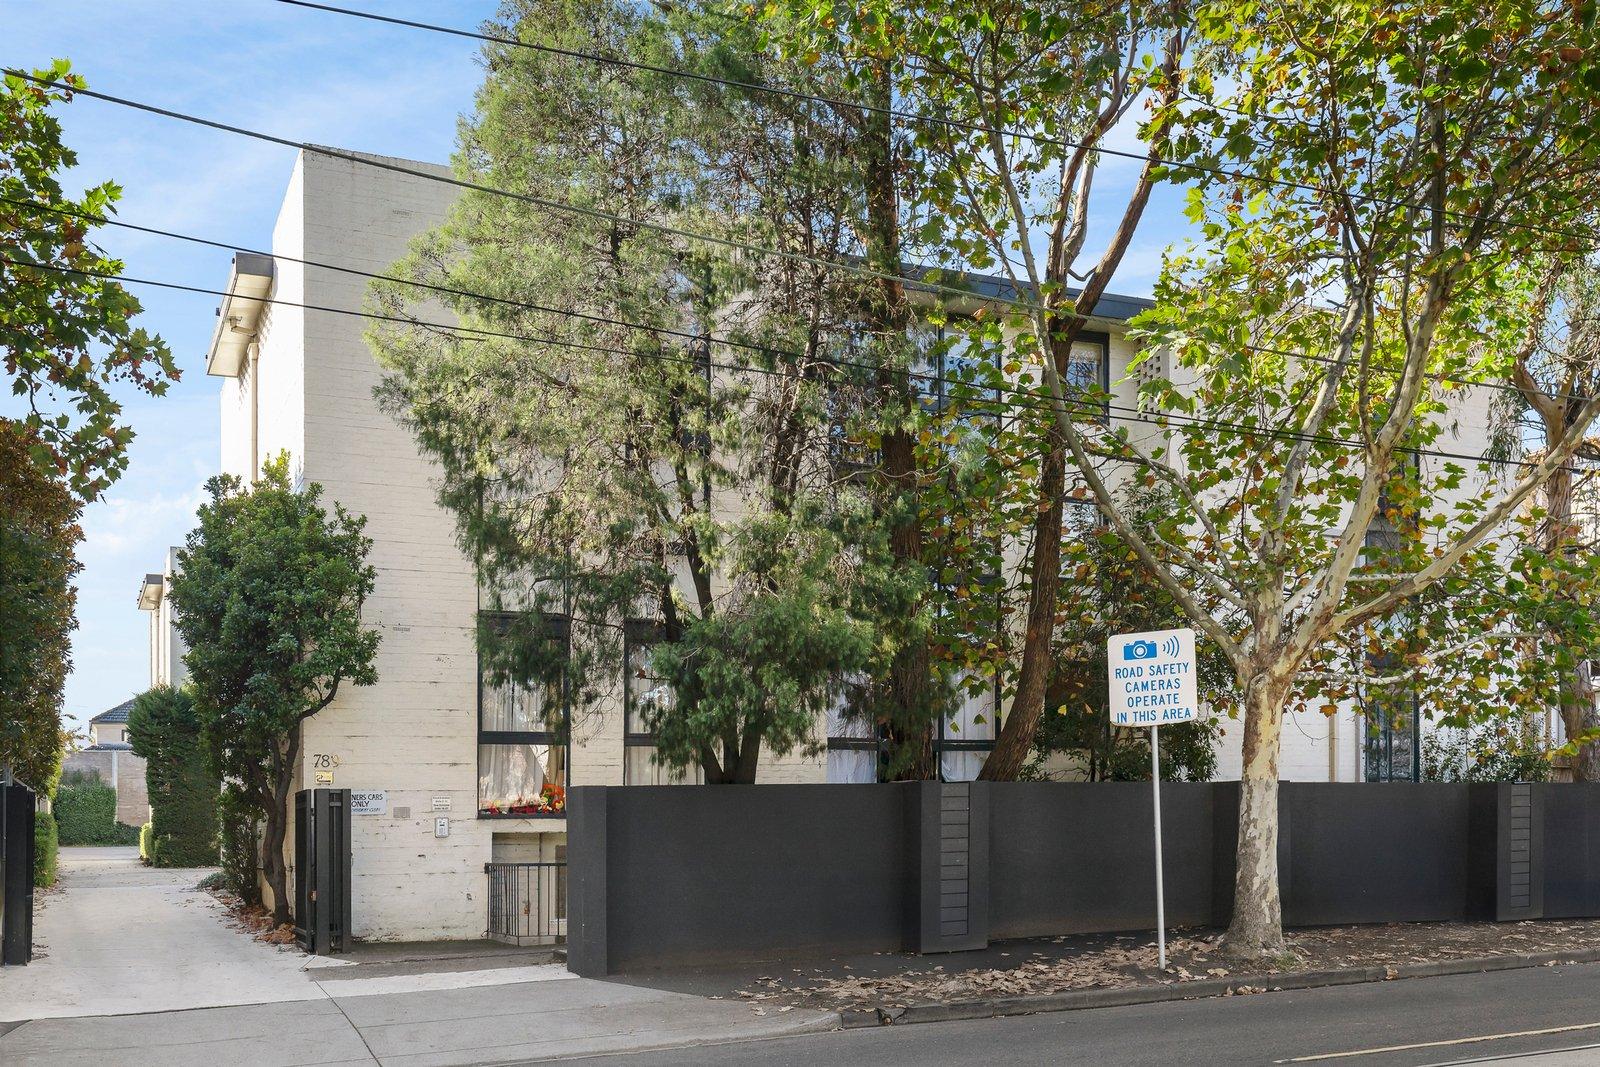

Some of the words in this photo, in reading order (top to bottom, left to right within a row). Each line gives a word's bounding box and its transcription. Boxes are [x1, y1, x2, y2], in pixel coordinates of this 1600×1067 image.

[1115, 666, 1143, 679] ROAD
[1149, 662, 1189, 676] SAFETY
[1125, 678, 1181, 693] CAMERAS
[1127, 693, 1180, 708] OPERATE
[1116, 712, 1127, 723] IN
[1133, 709, 1156, 722] THIS
[1162, 707, 1191, 720] AREA
[351, 794, 367, 802] NERS
[368, 793, 384, 802] CARS
